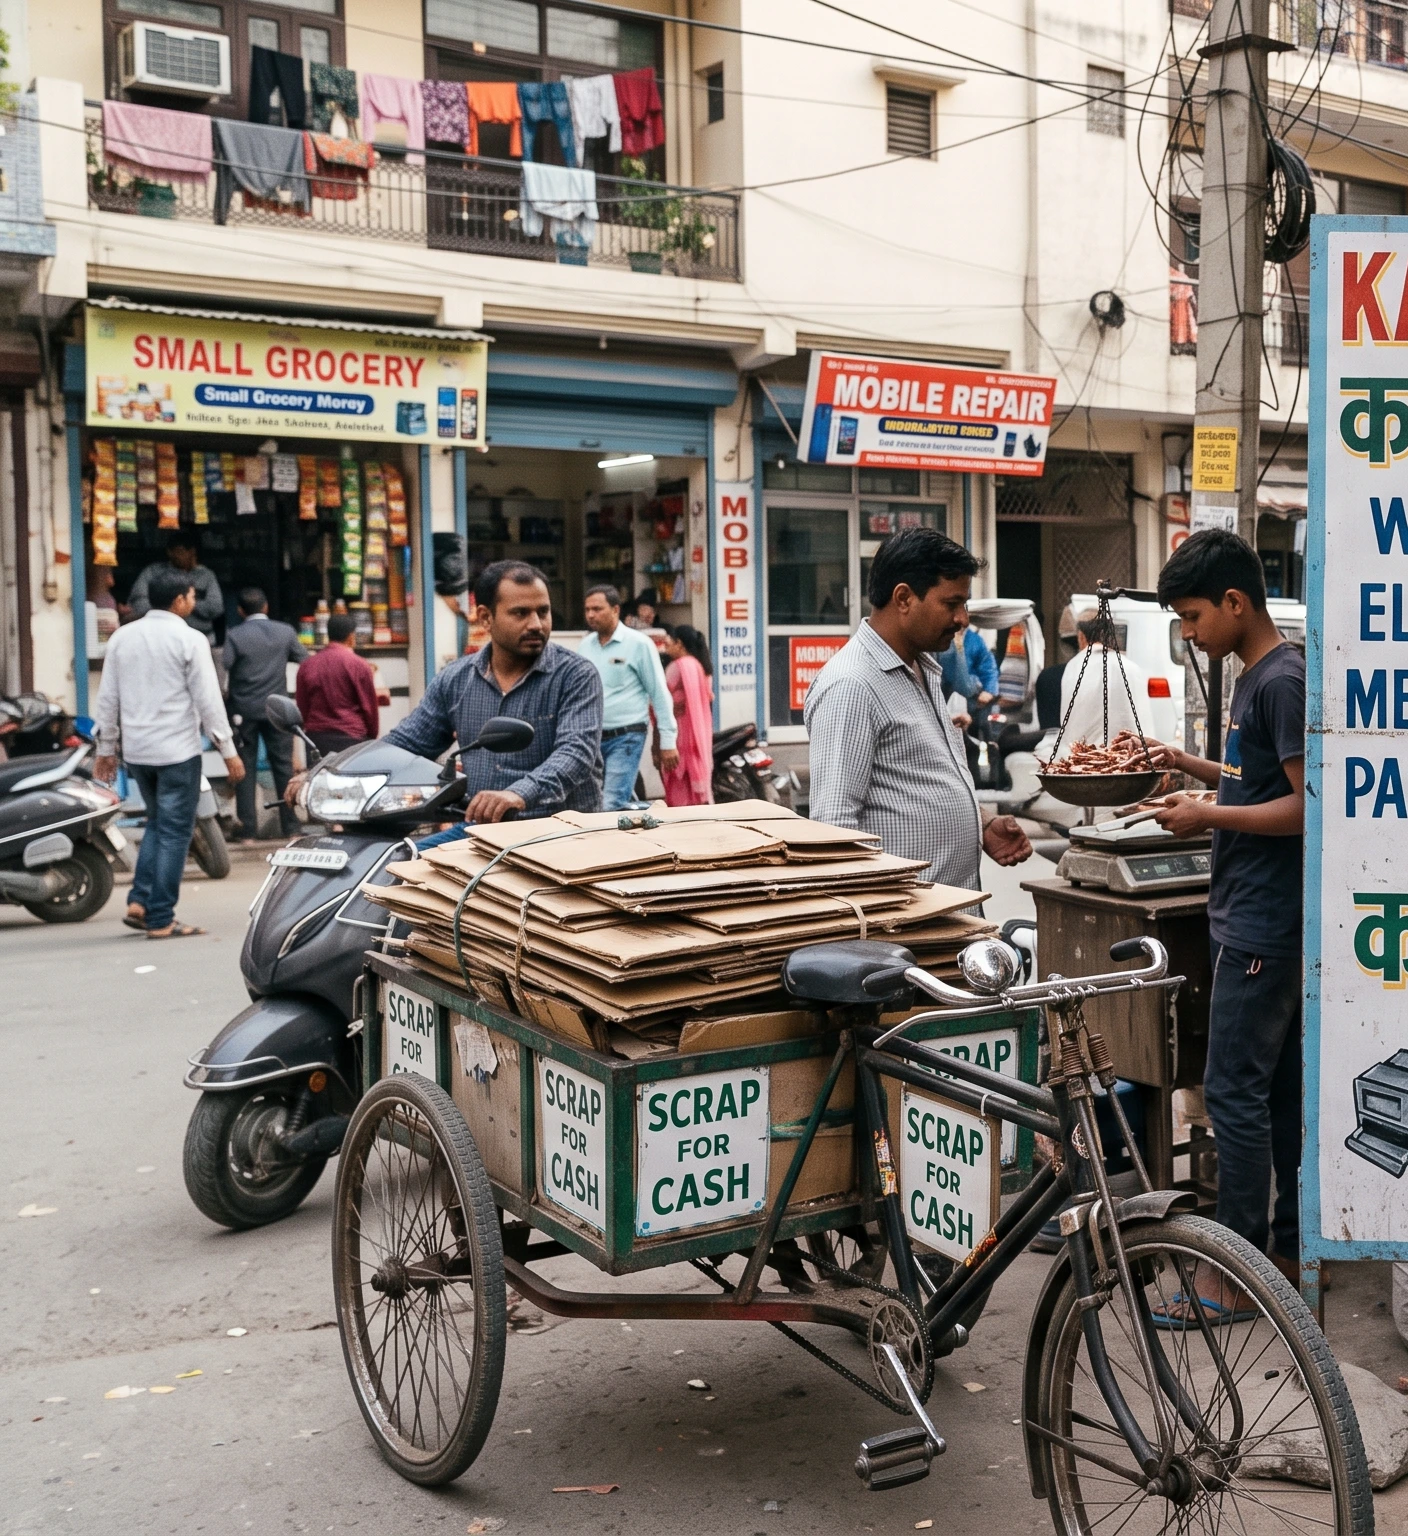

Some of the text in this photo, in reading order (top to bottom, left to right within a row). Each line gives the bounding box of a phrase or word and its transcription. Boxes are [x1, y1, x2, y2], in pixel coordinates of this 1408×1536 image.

[134, 334, 425, 388] SMALL GROCERY
[203, 387, 249, 404] Small
[253, 390, 313, 411] Grocery
[833, 374, 1048, 422] MOBILE REPAIR
[388, 989, 435, 1039] SCRAP
[401, 1036, 423, 1065] FOR
[544, 1068, 602, 1128] SCRAP
[648, 1078, 761, 1132] SCRAP
[560, 1122, 588, 1157] FOR
[677, 1133, 731, 1162] FOR
[906, 1106, 984, 1168] SCRAP
[550, 1151, 600, 1212] CASH
[651, 1162, 750, 1216] CASH
[926, 1160, 961, 1197] FOR
[910, 1188, 974, 1250] CASH
